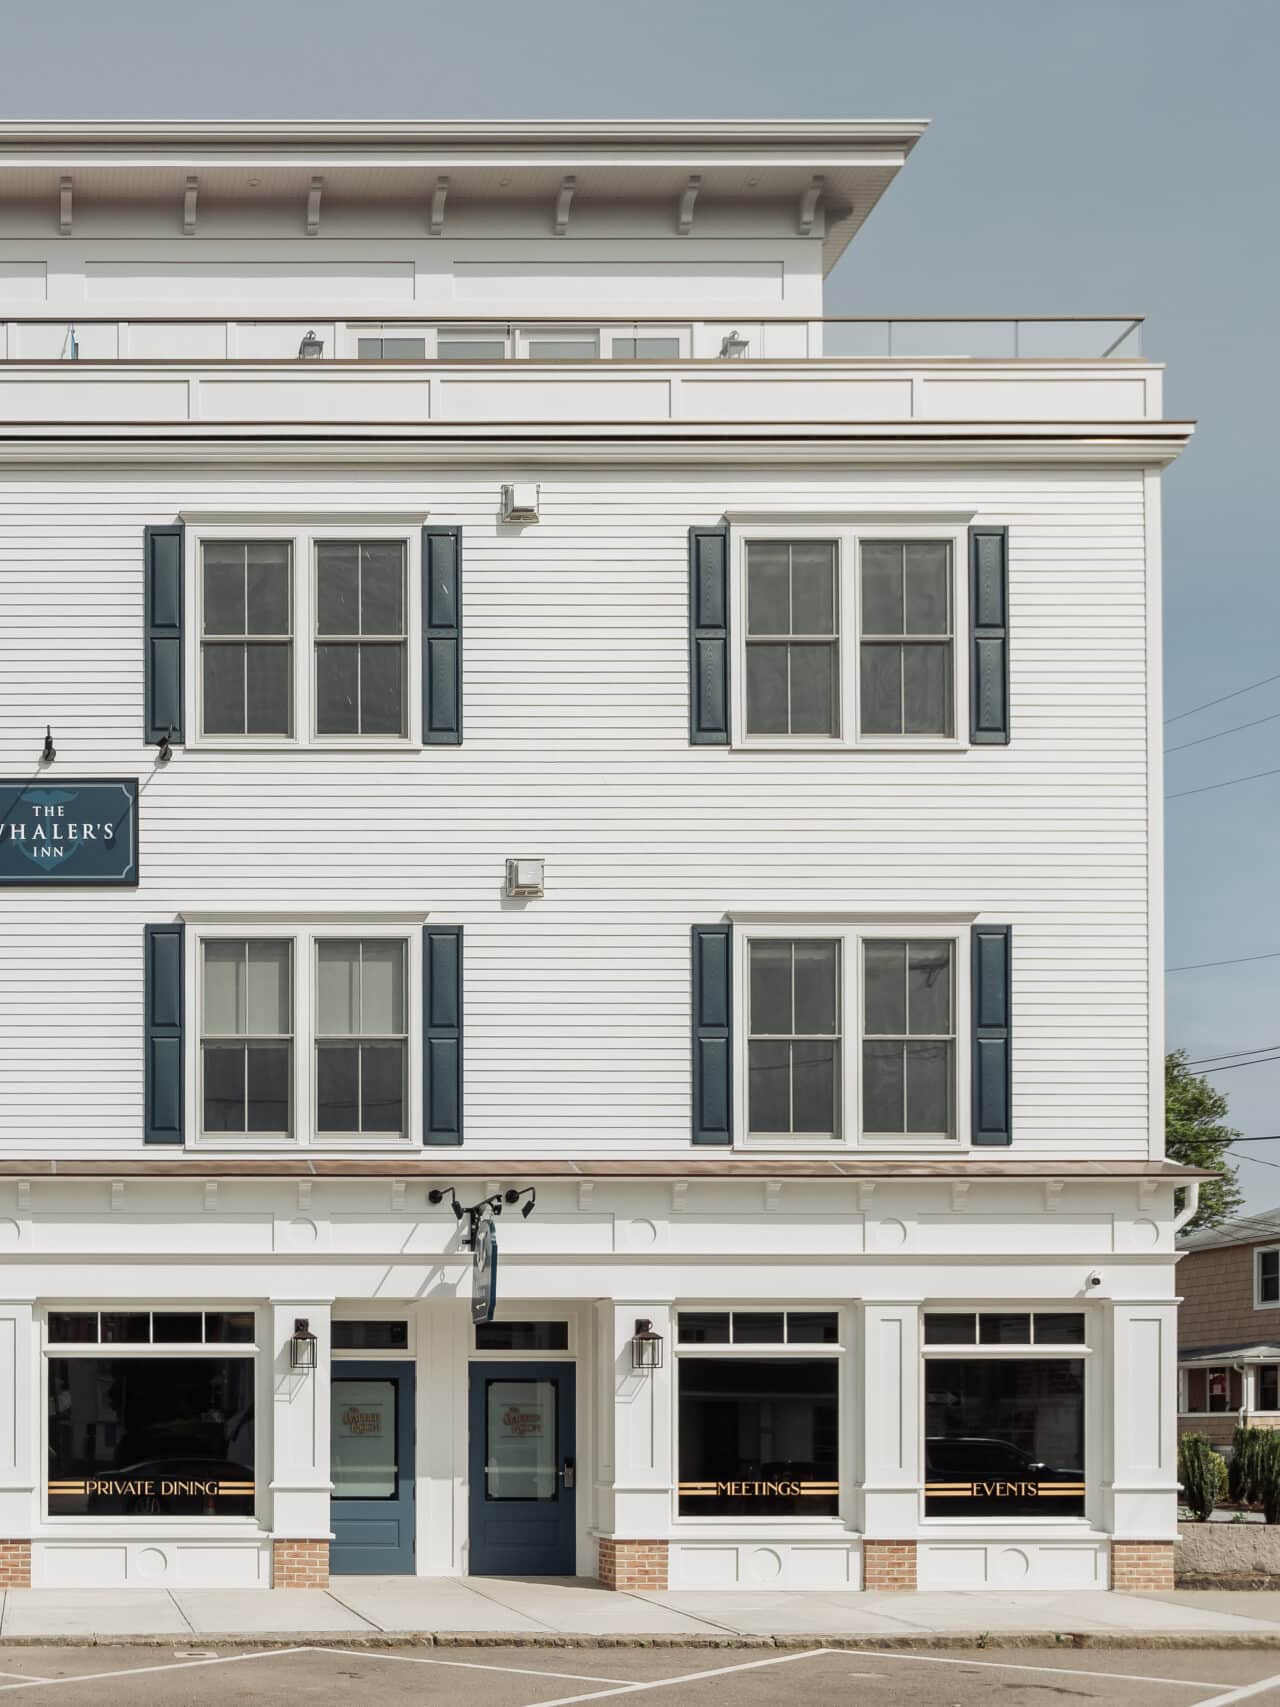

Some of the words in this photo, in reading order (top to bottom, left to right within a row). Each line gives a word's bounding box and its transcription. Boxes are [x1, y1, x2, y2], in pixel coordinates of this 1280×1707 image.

[32, 805, 65, 817] THE
[33, 846, 64, 857] INN
[86, 1481, 155, 1495] PRIVATE
[161, 1481, 218, 1495] DINING
[717, 1481, 801, 1496] MEETINGS
[972, 1482, 1038, 1497] EVENTS
